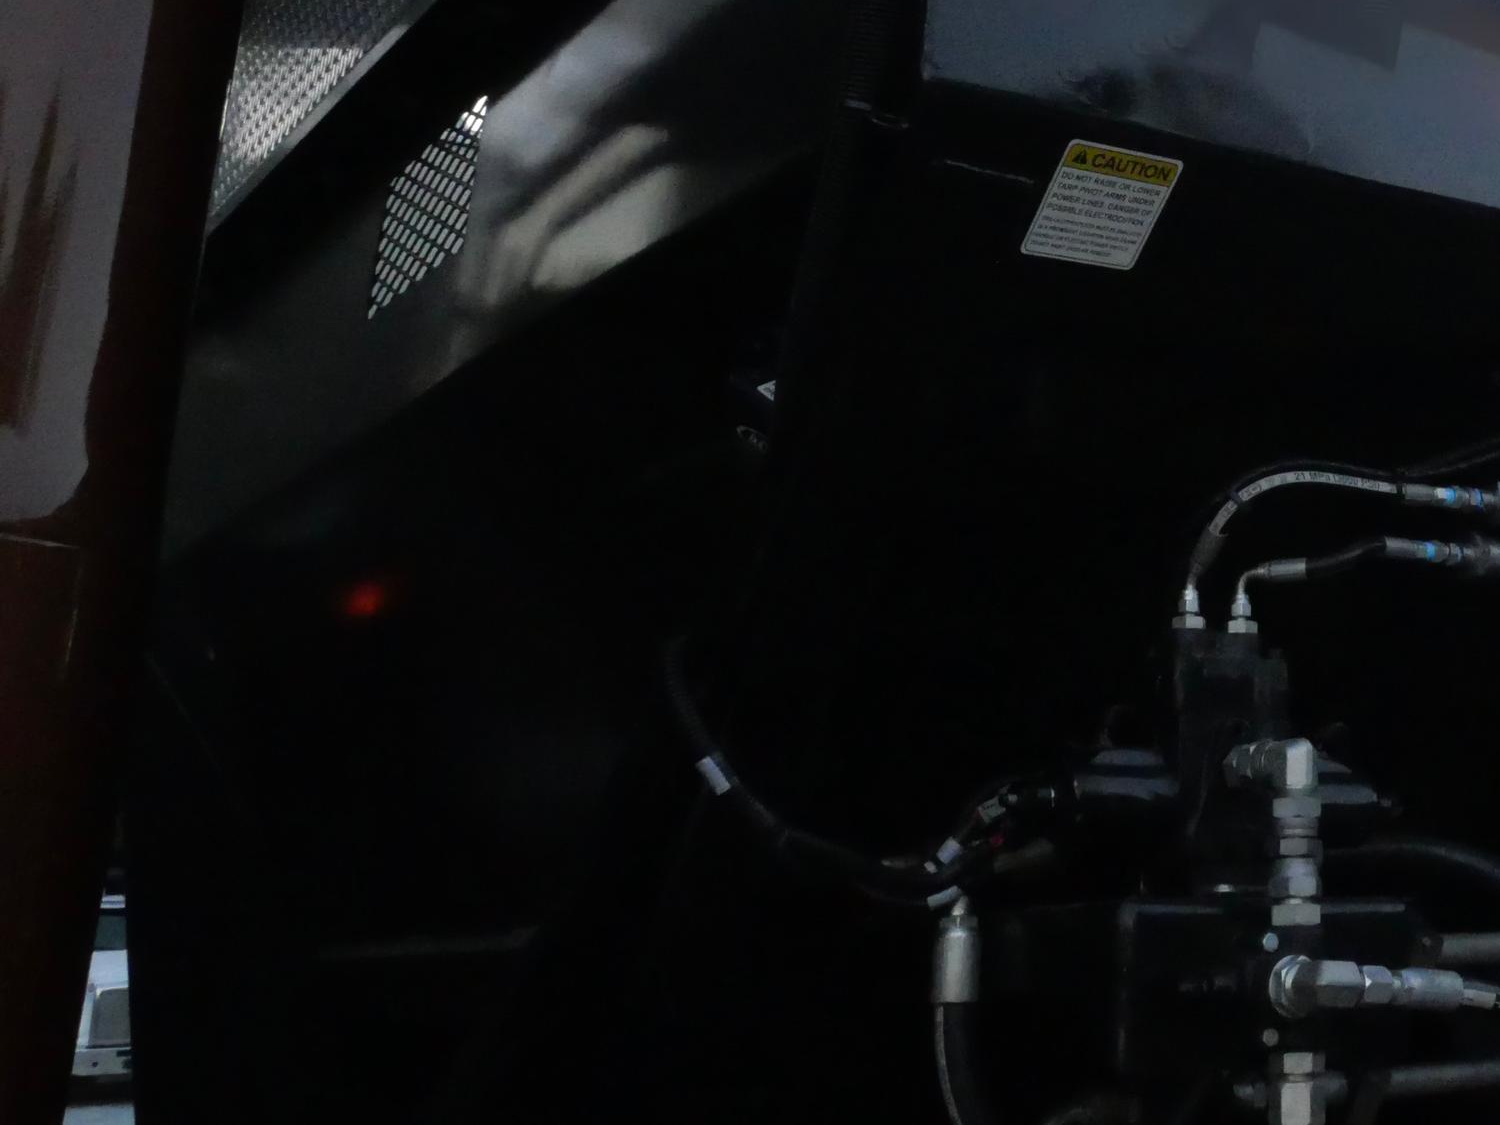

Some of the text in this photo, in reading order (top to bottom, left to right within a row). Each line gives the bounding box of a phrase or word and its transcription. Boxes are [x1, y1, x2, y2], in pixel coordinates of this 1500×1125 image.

[1091, 153, 1172, 181] CAUTION
[1057, 181, 1078, 191] TARP
[1104, 190, 1127, 201] ARMS
[1127, 196, 1155, 207] UNDER
[1060, 171, 1075, 180] DO
[1075, 173, 1092, 183] NOT
[1118, 182, 1131, 191] OR
[1132, 185, 1161, 196] LOWER
[1051, 192, 1080, 203] POWER
